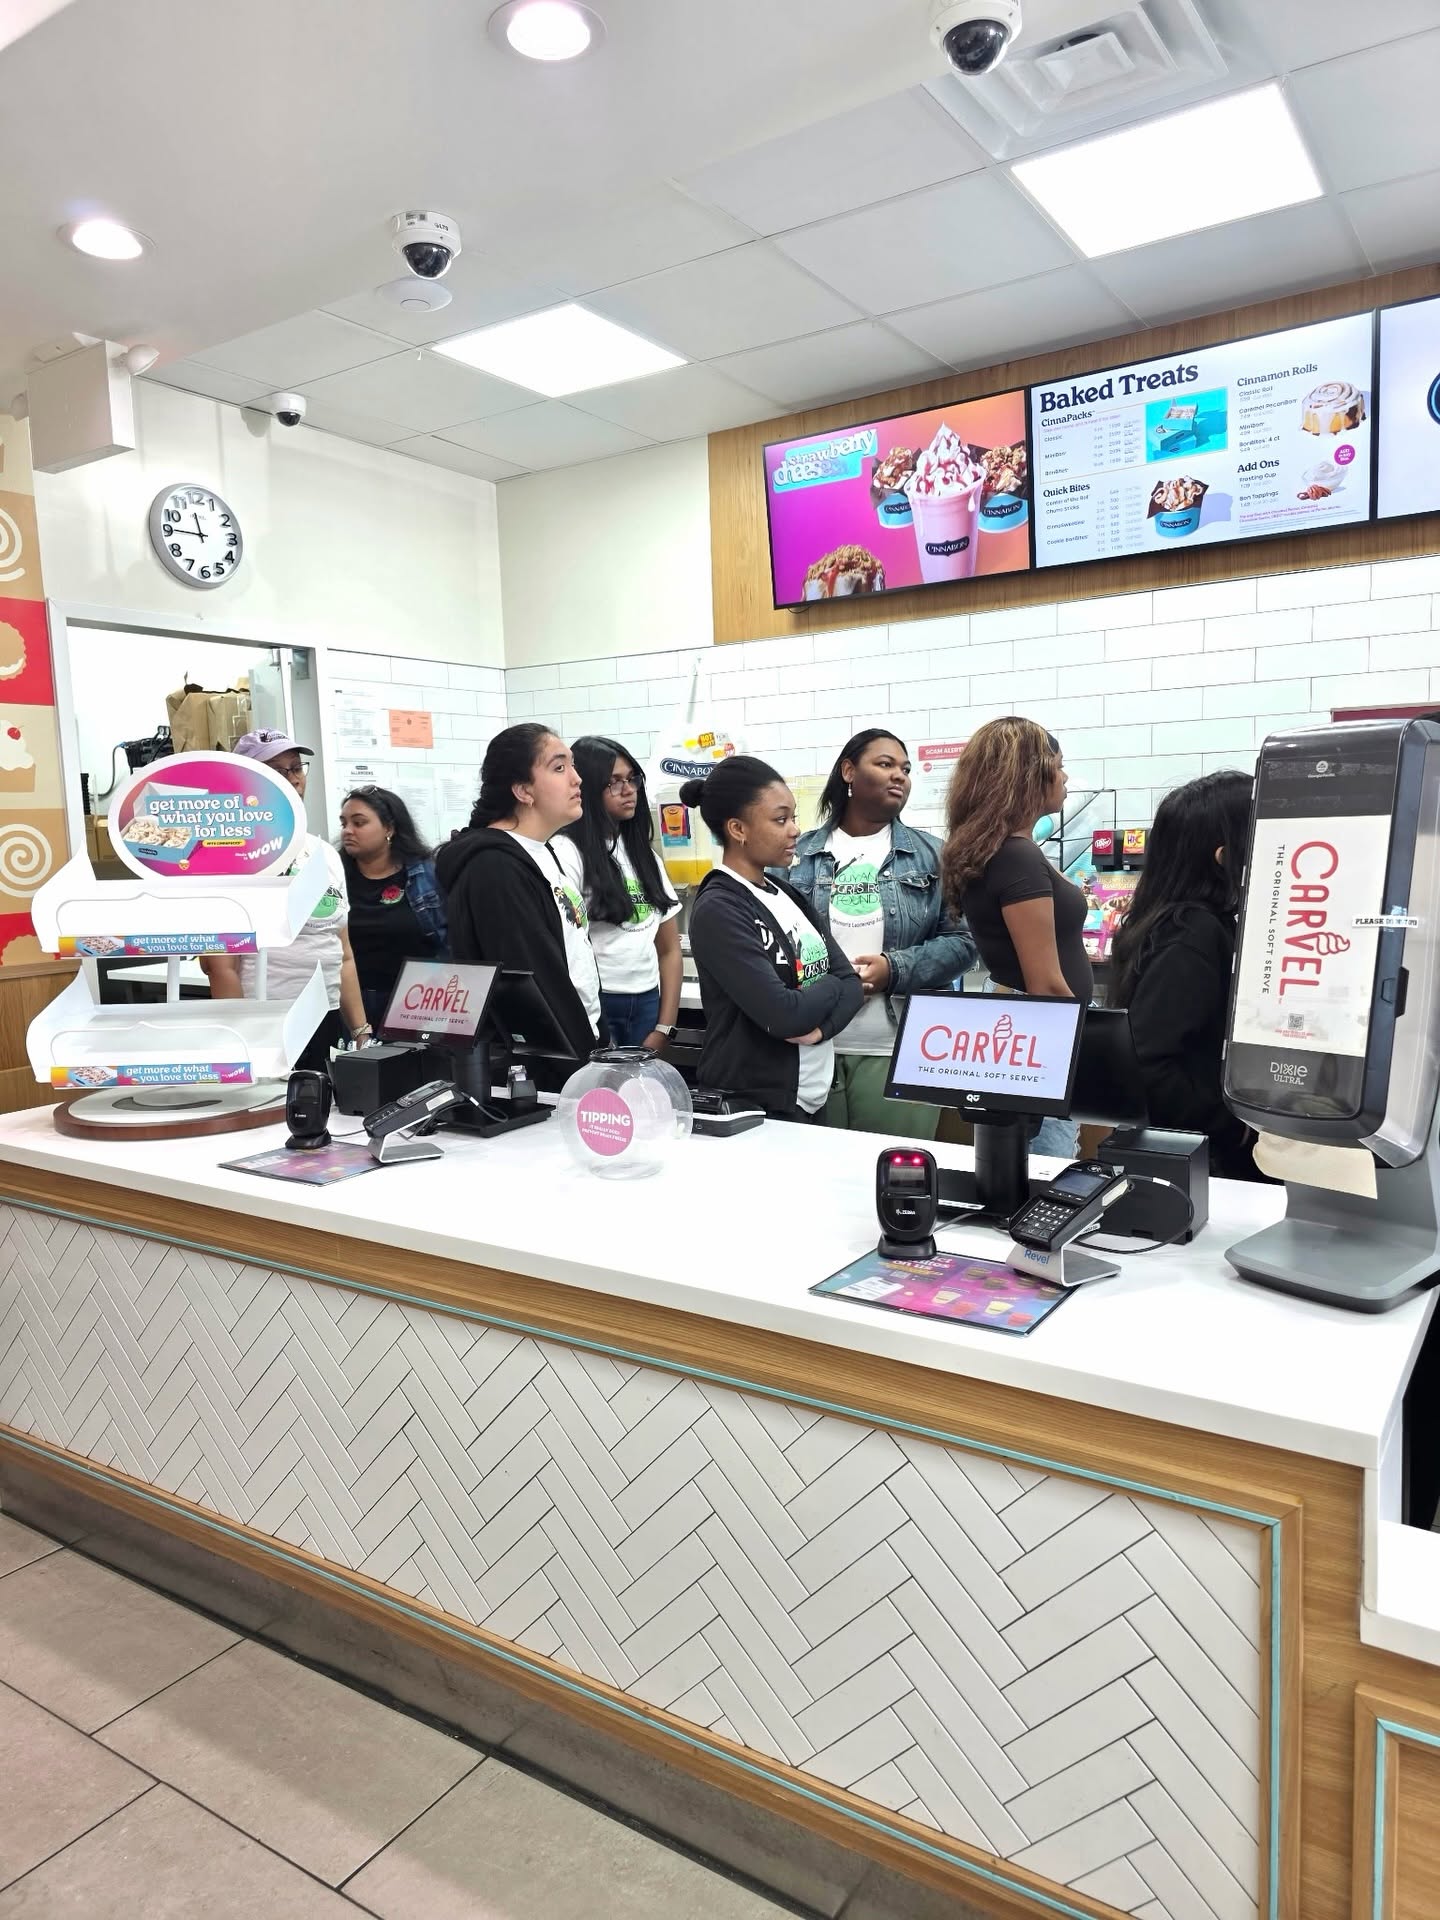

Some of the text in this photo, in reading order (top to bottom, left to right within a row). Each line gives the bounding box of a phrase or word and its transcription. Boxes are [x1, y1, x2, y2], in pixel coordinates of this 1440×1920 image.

[1237, 363, 1318, 387] Cinnamon Rolls
[1040, 364, 1199, 413] Baked Treats
[1041, 410, 1093, 427] CinnaPacks
[788, 429, 877, 466] strawberry
[1237, 460, 1280, 473] Add Ons
[1043, 483, 1090, 498] Quick Bites
[172, 495, 187, 509] 11
[186, 491, 205, 505] 12
[208, 498, 215, 511] 1
[164, 508, 181, 522] 10
[983, 502, 1020, 516] CINNABON
[220, 514, 231, 527] 2
[162, 523, 173, 537] 9
[227, 533, 238, 546] 3
[170, 543, 182, 557] 8
[927, 541, 968, 553] CINNABON
[225, 550, 235, 564] 4
[185, 558, 195, 571] 7
[214, 562, 225, 575] 5
[200, 566, 211, 579] 6
[150, 796, 240, 815] get more of
[160, 809, 273, 825] what you love
[194, 824, 252, 838] for less
[248, 836, 283, 860] WOW
[836, 894, 880, 905] FOUND
[1262, 844, 1286, 994] THE ORIGINAL SOFT SERVE
[1279, 841, 1340, 997] CARVEL
[133, 934, 215, 946] get more of what
[147, 941, 225, 953] you love for less
[234, 936, 251, 949] WOW
[404, 983, 471, 1014] CARVEL
[411, 1014, 434, 1022] ORIGINAL
[921, 1018, 1042, 1068] CARVEL
[126, 1066, 142, 1076] get
[172, 1065, 182, 1073] of
[183, 1064, 209, 1073] what
[228, 1066, 245, 1078] WOW
[918, 1065, 1039, 1083] THE ORIGINAL SOFT SERVE
[140, 1075, 158, 1083] you
[160, 1073, 182, 1081] love
[199, 1072, 219, 1080] less
[1273, 1074, 1302, 1085] ULTRA
[581, 1110, 631, 1126] TIPPING
[1023, 1249, 1050, 1265] Revel
